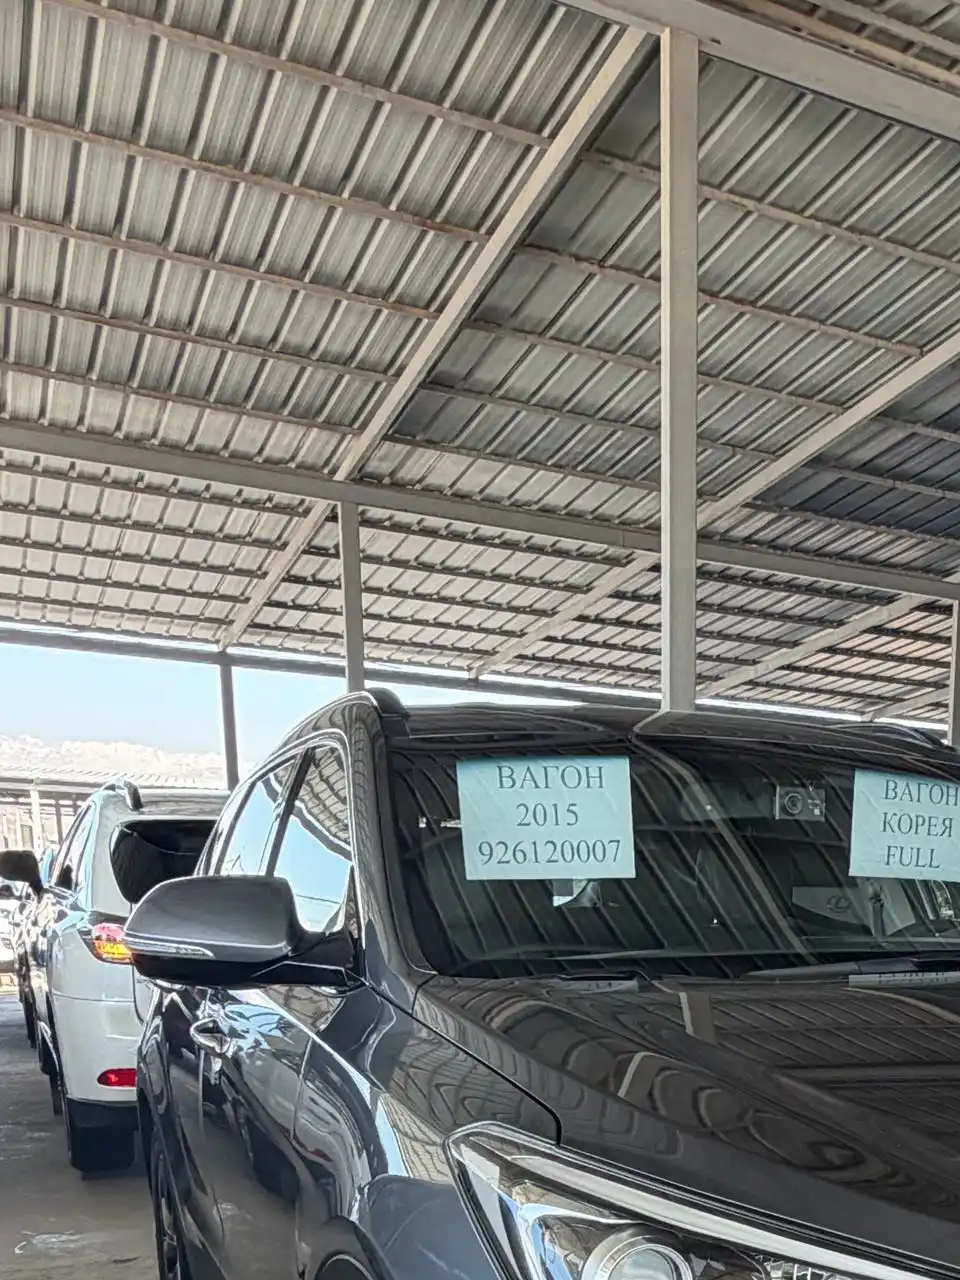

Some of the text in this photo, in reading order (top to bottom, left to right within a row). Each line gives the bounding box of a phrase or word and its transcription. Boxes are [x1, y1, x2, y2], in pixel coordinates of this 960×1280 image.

[496, 764, 604, 790] ВАГОН
[884, 779, 959, 806] ВАГОН
[515, 802, 579, 828] 2015
[882, 812, 954, 838] КОРЕЯ
[477, 838, 622, 866] 926120007
[885, 845, 941, 869] FULL
